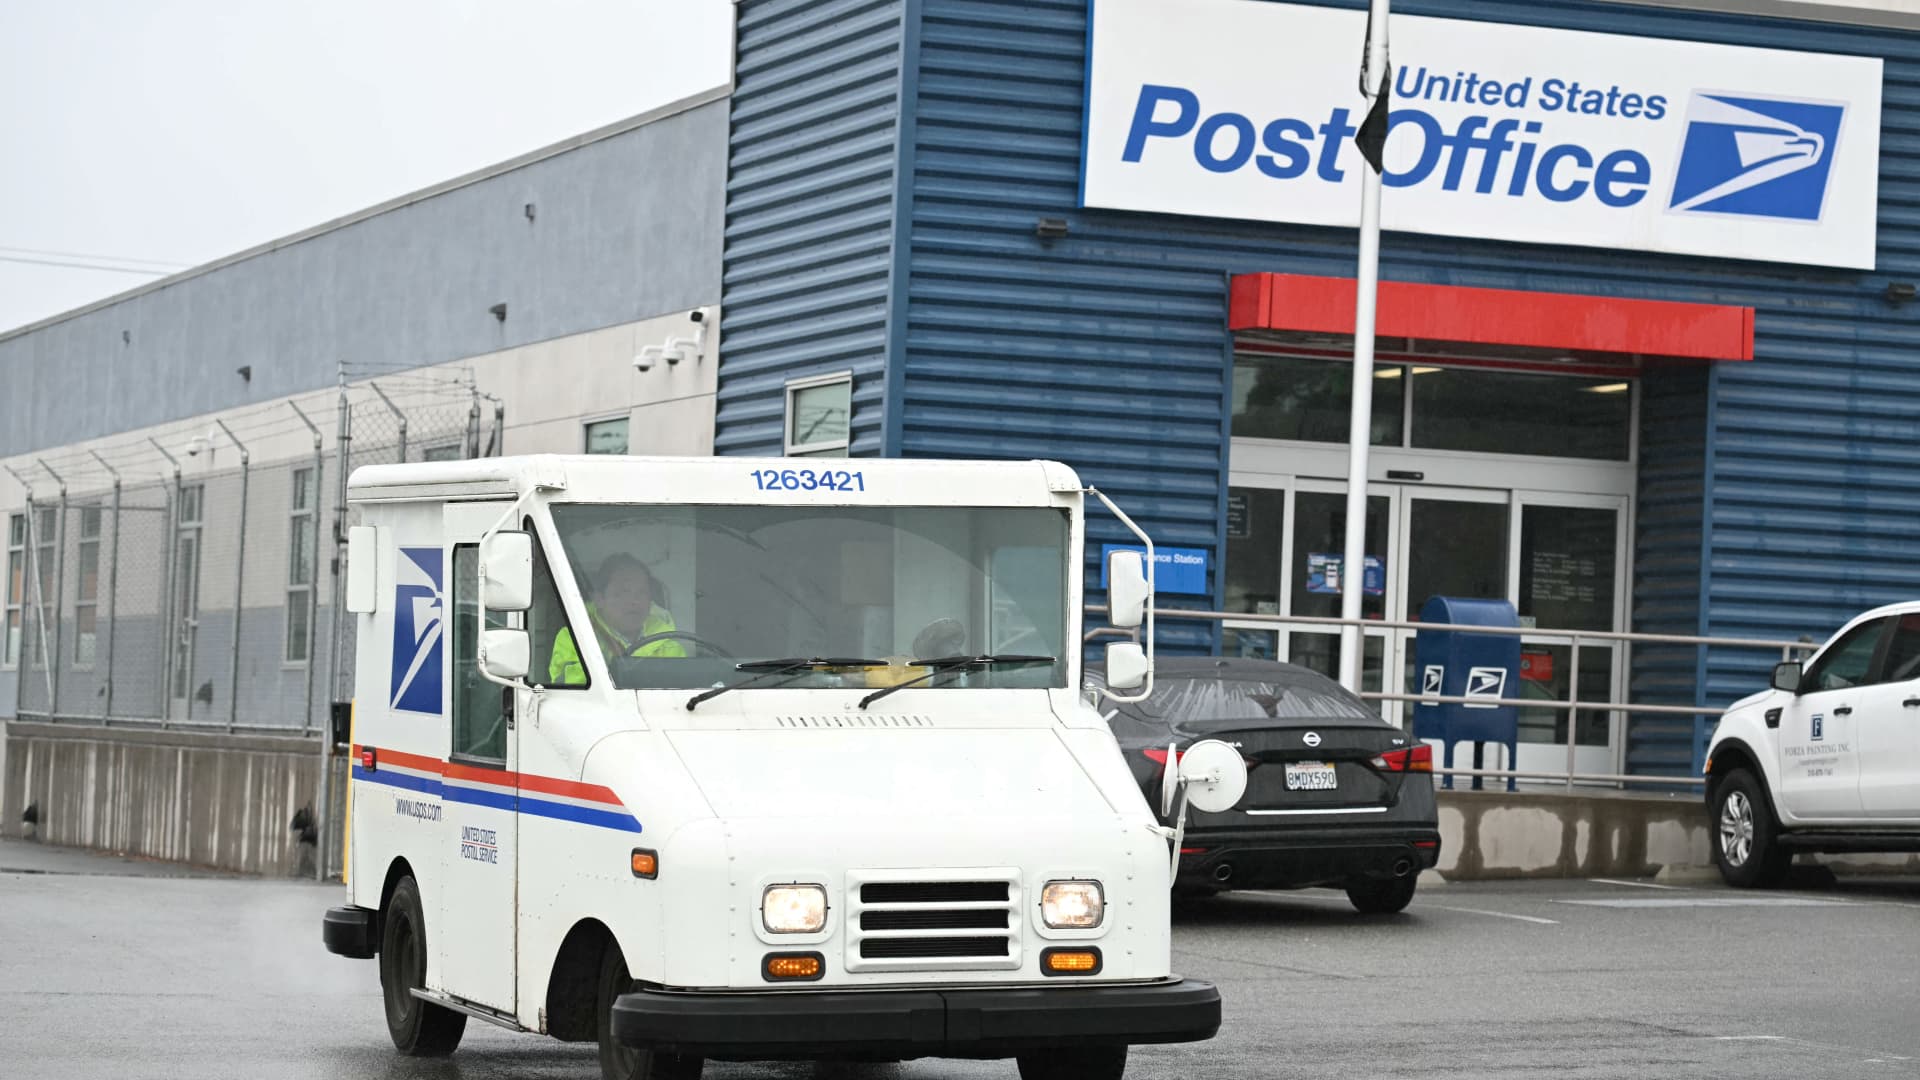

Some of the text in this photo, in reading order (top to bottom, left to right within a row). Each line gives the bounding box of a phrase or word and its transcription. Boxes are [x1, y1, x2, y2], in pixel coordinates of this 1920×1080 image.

[1395, 66, 1667, 120] United States
[1121, 84, 1651, 208] Post Office
[751, 469, 865, 492] 1263421
[1174, 553, 1204, 565] Station
[1287, 771, 1336, 786] 8MDX590
[396, 798, 442, 823] www.usps.com
[462, 825, 497, 845] UNITED STATES
[461, 844, 498, 864] POSTAL SERVICE
